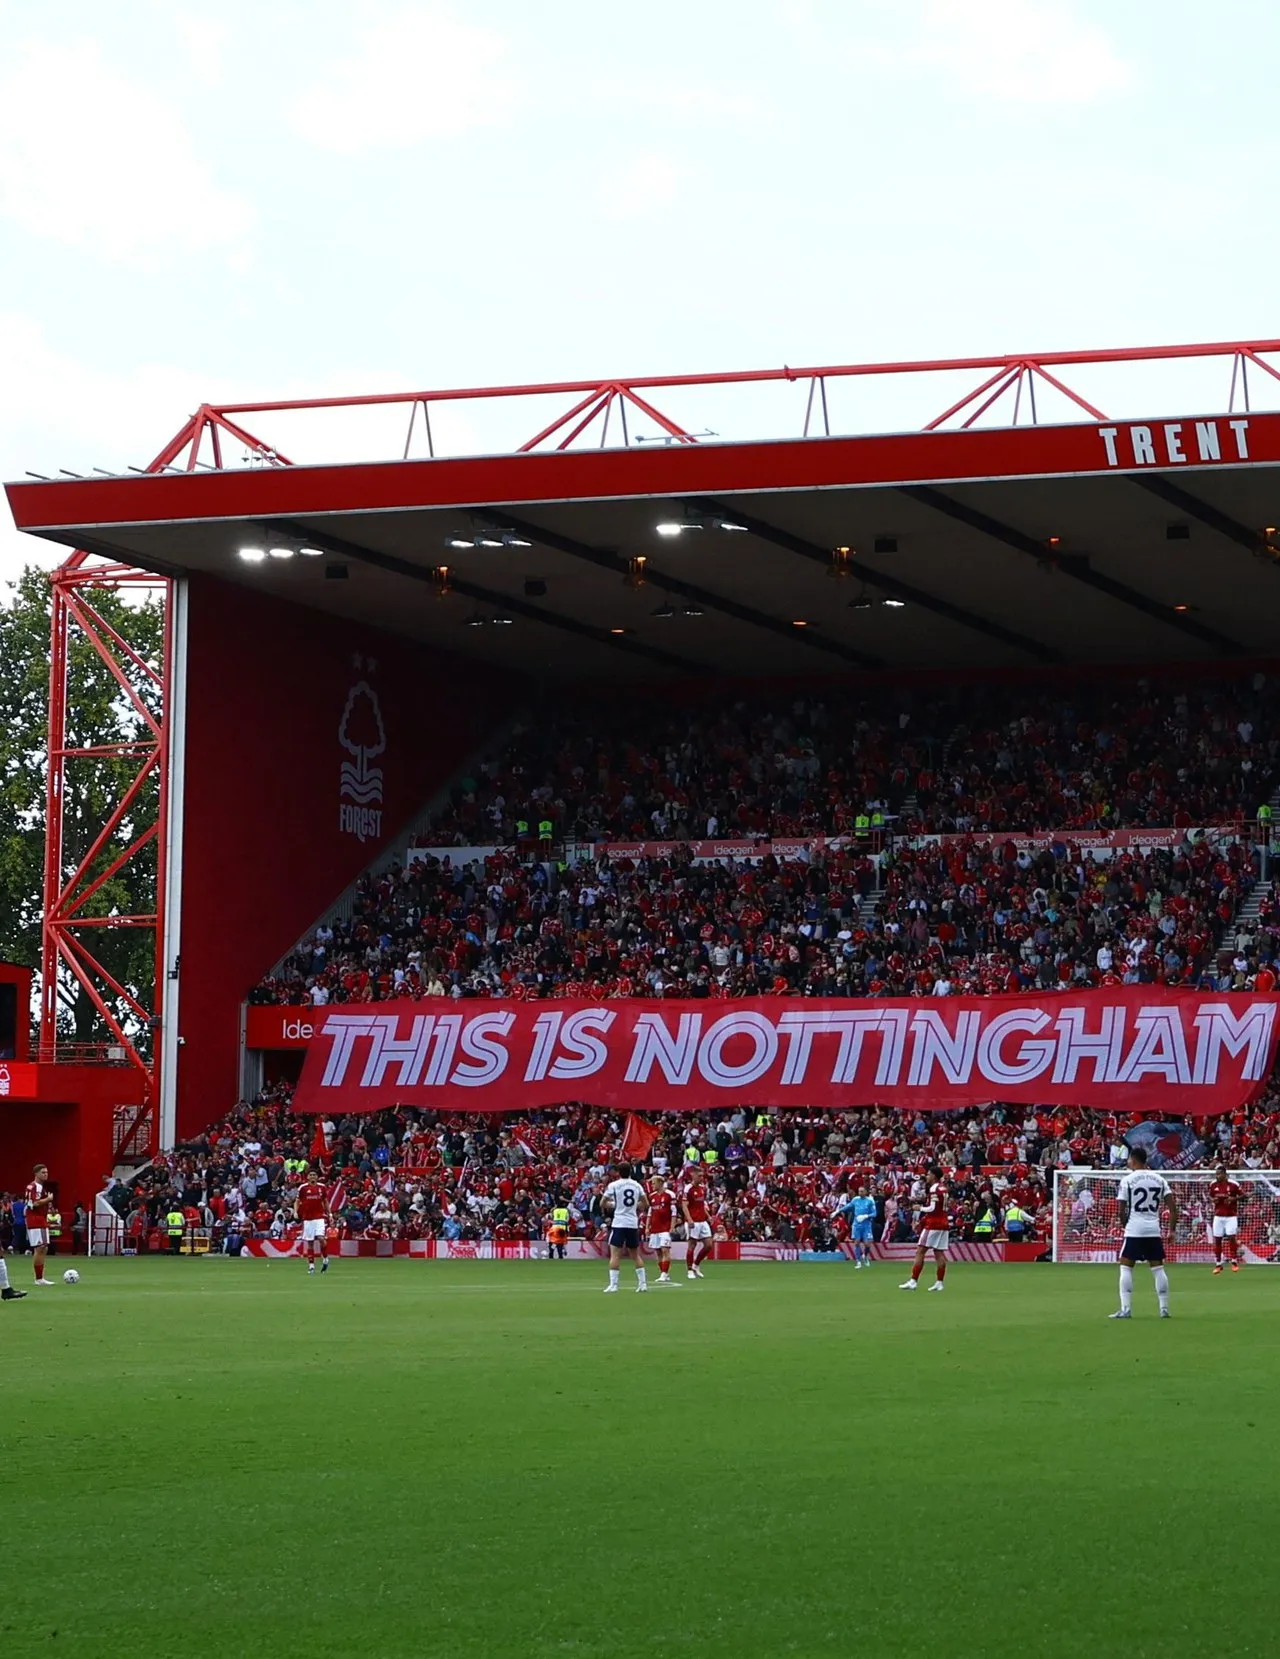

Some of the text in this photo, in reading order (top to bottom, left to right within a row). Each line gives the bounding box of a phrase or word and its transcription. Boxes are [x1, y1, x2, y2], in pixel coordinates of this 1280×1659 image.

[1099, 420, 1248, 466] TRENT
[1068, 836, 1109, 847] deagen
[1129, 835, 1171, 846] Ideagen
[714, 845, 754, 856] Ideagen
[771, 843, 810, 857] Ideag
[283, 1019, 313, 1039] Ide
[321, 1002, 1278, 1087] THIS IS NOTTINGHAM
[623, 1189, 635, 1207] 8
[1134, 1187, 1161, 1212] 23
